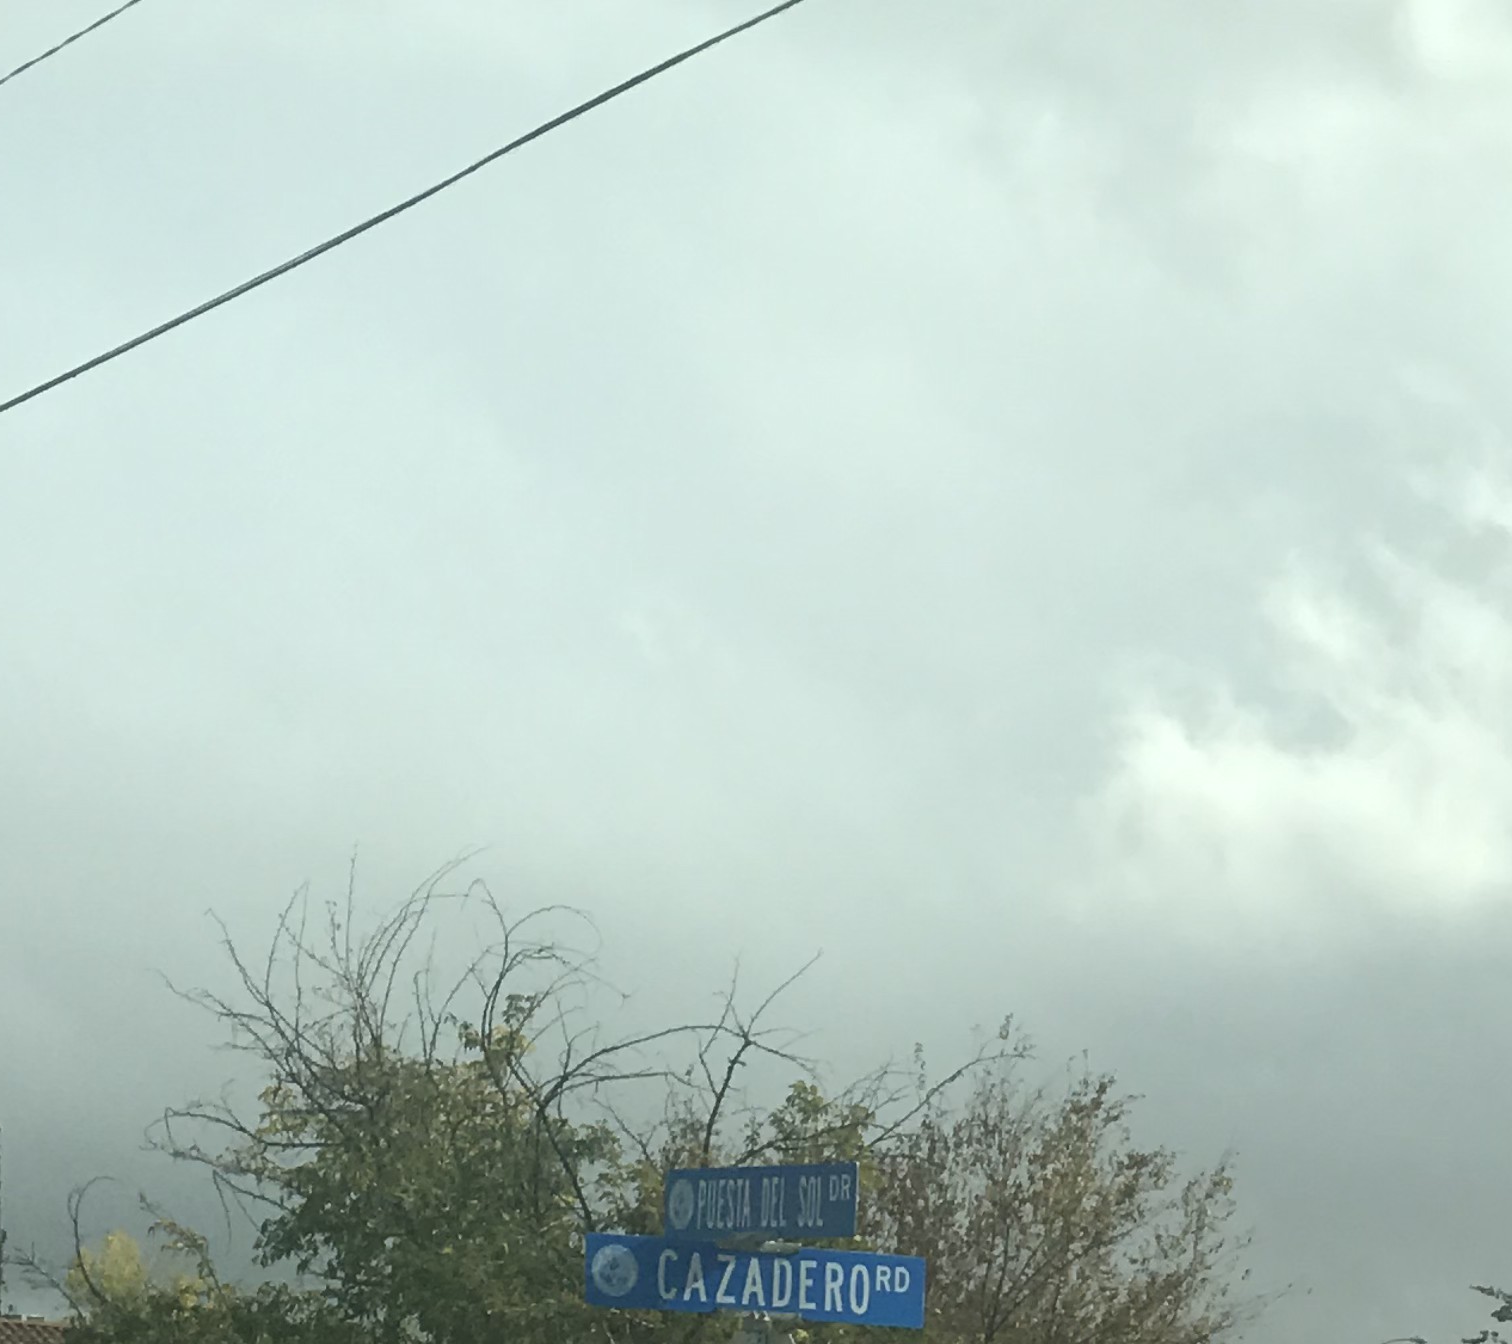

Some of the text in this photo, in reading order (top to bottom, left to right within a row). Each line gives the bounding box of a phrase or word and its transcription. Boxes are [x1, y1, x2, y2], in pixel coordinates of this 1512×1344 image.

[697, 1174, 851, 1230] PUESTA DEL SOL DR
[657, 1248, 910, 1315] CAZADERO RD
